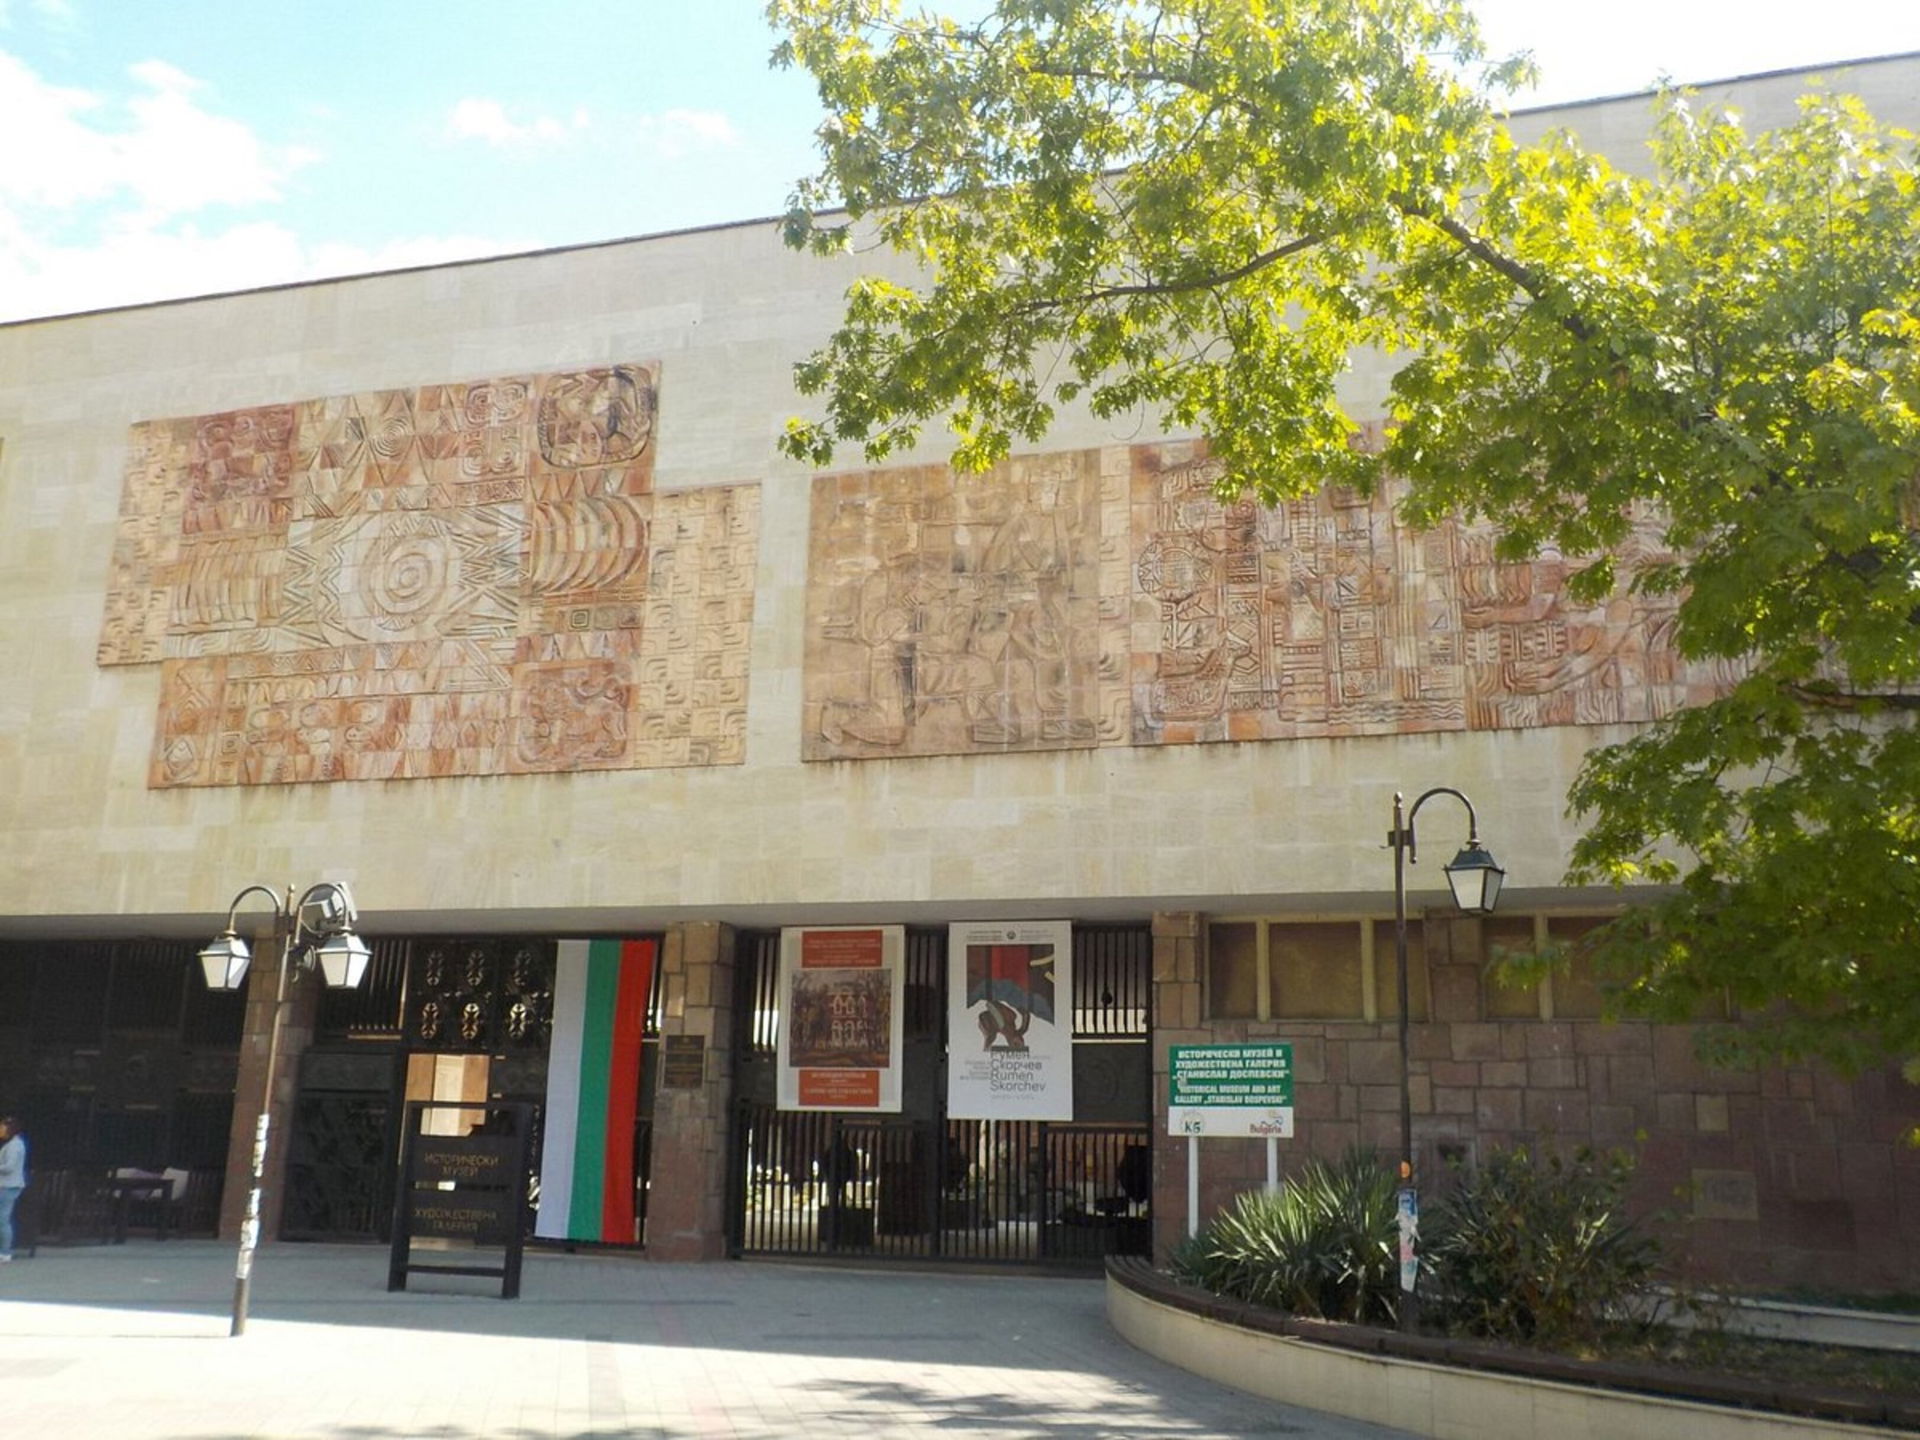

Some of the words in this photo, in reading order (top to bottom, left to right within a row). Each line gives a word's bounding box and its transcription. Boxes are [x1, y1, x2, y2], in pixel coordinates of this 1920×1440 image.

[1178, 1050, 1240, 1059] ИСТОРИЧЕСКИ
[1242, 1048, 1273, 1058] МУЗЕЙ
[1275, 1049, 1282, 1058] И
[991, 1060, 1042, 1071] Скорчев
[1175, 1060, 1243, 1069] ХУДОЖЕСТВЕНА
[1245, 1059, 1286, 1068] ГАЛЕРИЯ
[991, 1070, 1034, 1081] Rumen
[990, 1080, 1046, 1092] Skorchev
[1219, 1085, 1250, 1093] MUSEUM
[1252, 1085, 1266, 1093] AND
[1267, 1085, 1281, 1093] ART
[1250, 1123, 1282, 1134] Bulgaria
[424, 1153, 499, 1166] ИСТОРИЧЕСКИ
